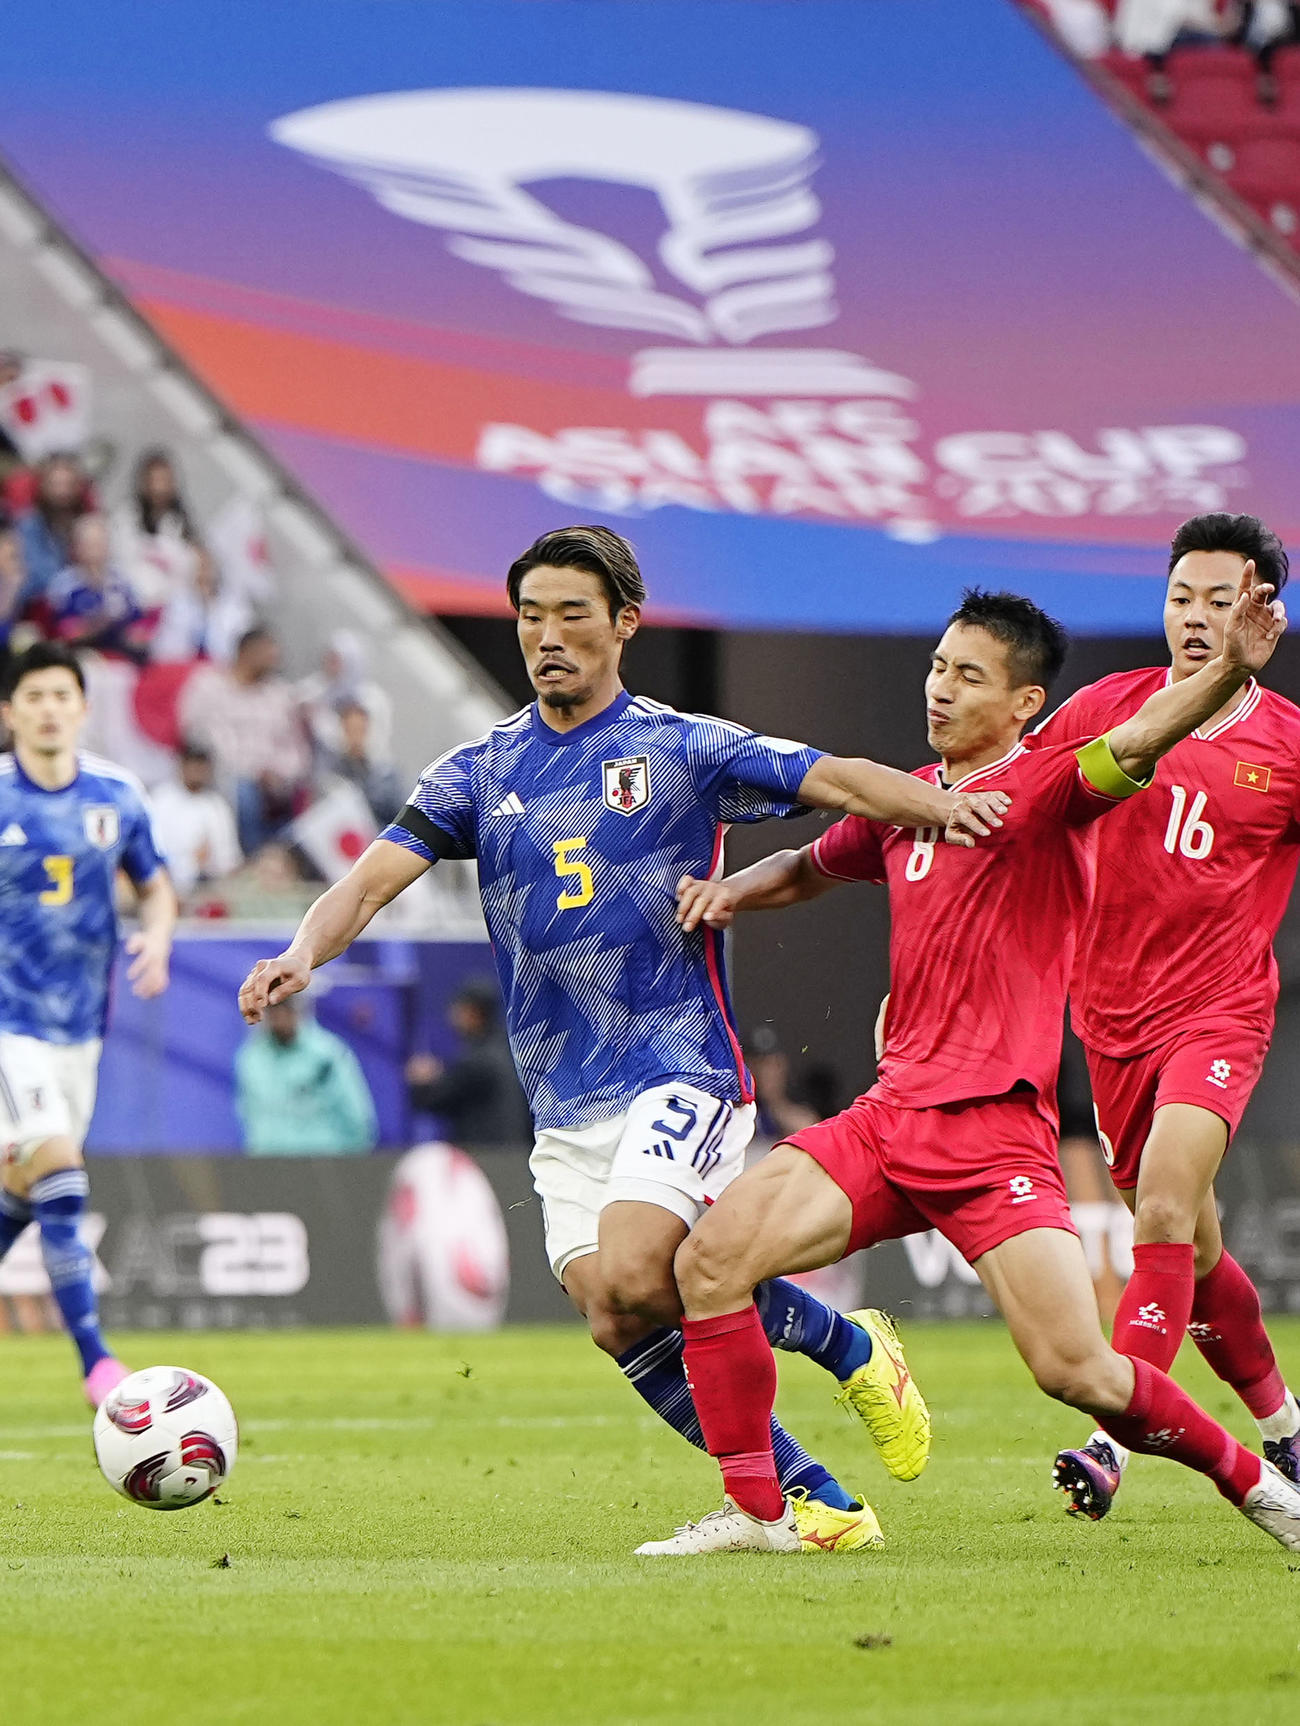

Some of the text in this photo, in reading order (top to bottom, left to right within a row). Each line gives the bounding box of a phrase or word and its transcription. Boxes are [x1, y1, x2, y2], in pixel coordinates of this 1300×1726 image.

[935, 423, 1247, 479] CUP
[617, 795, 637, 806] JFA
[1163, 784, 1215, 860] 16
[38, 854, 74, 907] 3
[553, 836, 595, 910] 5
[905, 825, 939, 882] 8
[650, 1094, 698, 1141] 5
